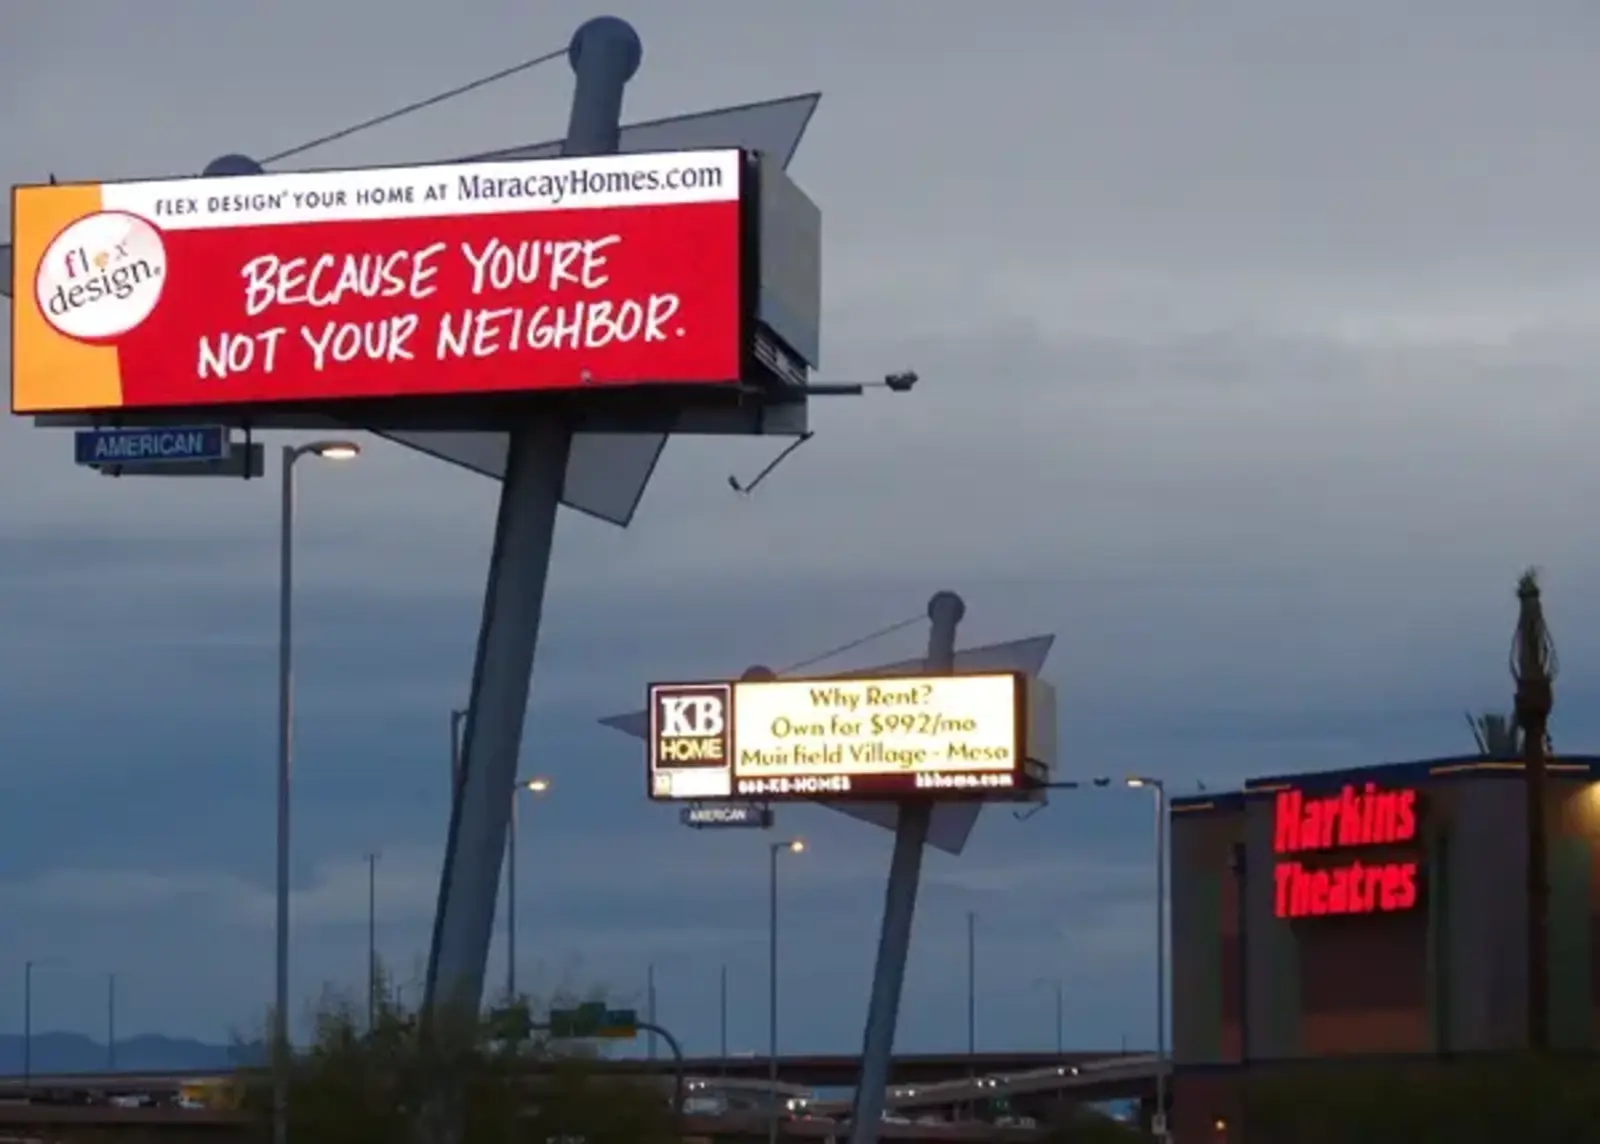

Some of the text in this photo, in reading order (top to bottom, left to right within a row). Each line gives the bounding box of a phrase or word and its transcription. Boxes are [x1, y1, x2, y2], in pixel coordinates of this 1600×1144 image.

[155, 198, 199, 216] FLEX
[293, 190, 348, 209] YOUR
[356, 186, 415, 205] HOME
[423, 183, 448, 202] AT
[458, 164, 723, 203] MaracayHomes.com
[64, 239, 130, 279] flex
[241, 234, 621, 316] BECAUSE YOU'RE
[197, 292, 687, 379] NOT YOUR NEIGHBOR.
[96, 432, 203, 457] AMERICAN
[660, 695, 724, 737] KB
[810, 684, 934, 711] Why Rent?
[771, 713, 977, 738] Own for $992/mo
[660, 738, 724, 762] HOME
[740, 743, 842, 767] Muirfield
[849, 742, 927, 769] Village
[947, 742, 1009, 761] Mesa
[690, 807, 747, 822] AMERICAN
[1275, 782, 1416, 854] Harkins
[1274, 860, 1418, 918] Theatres
